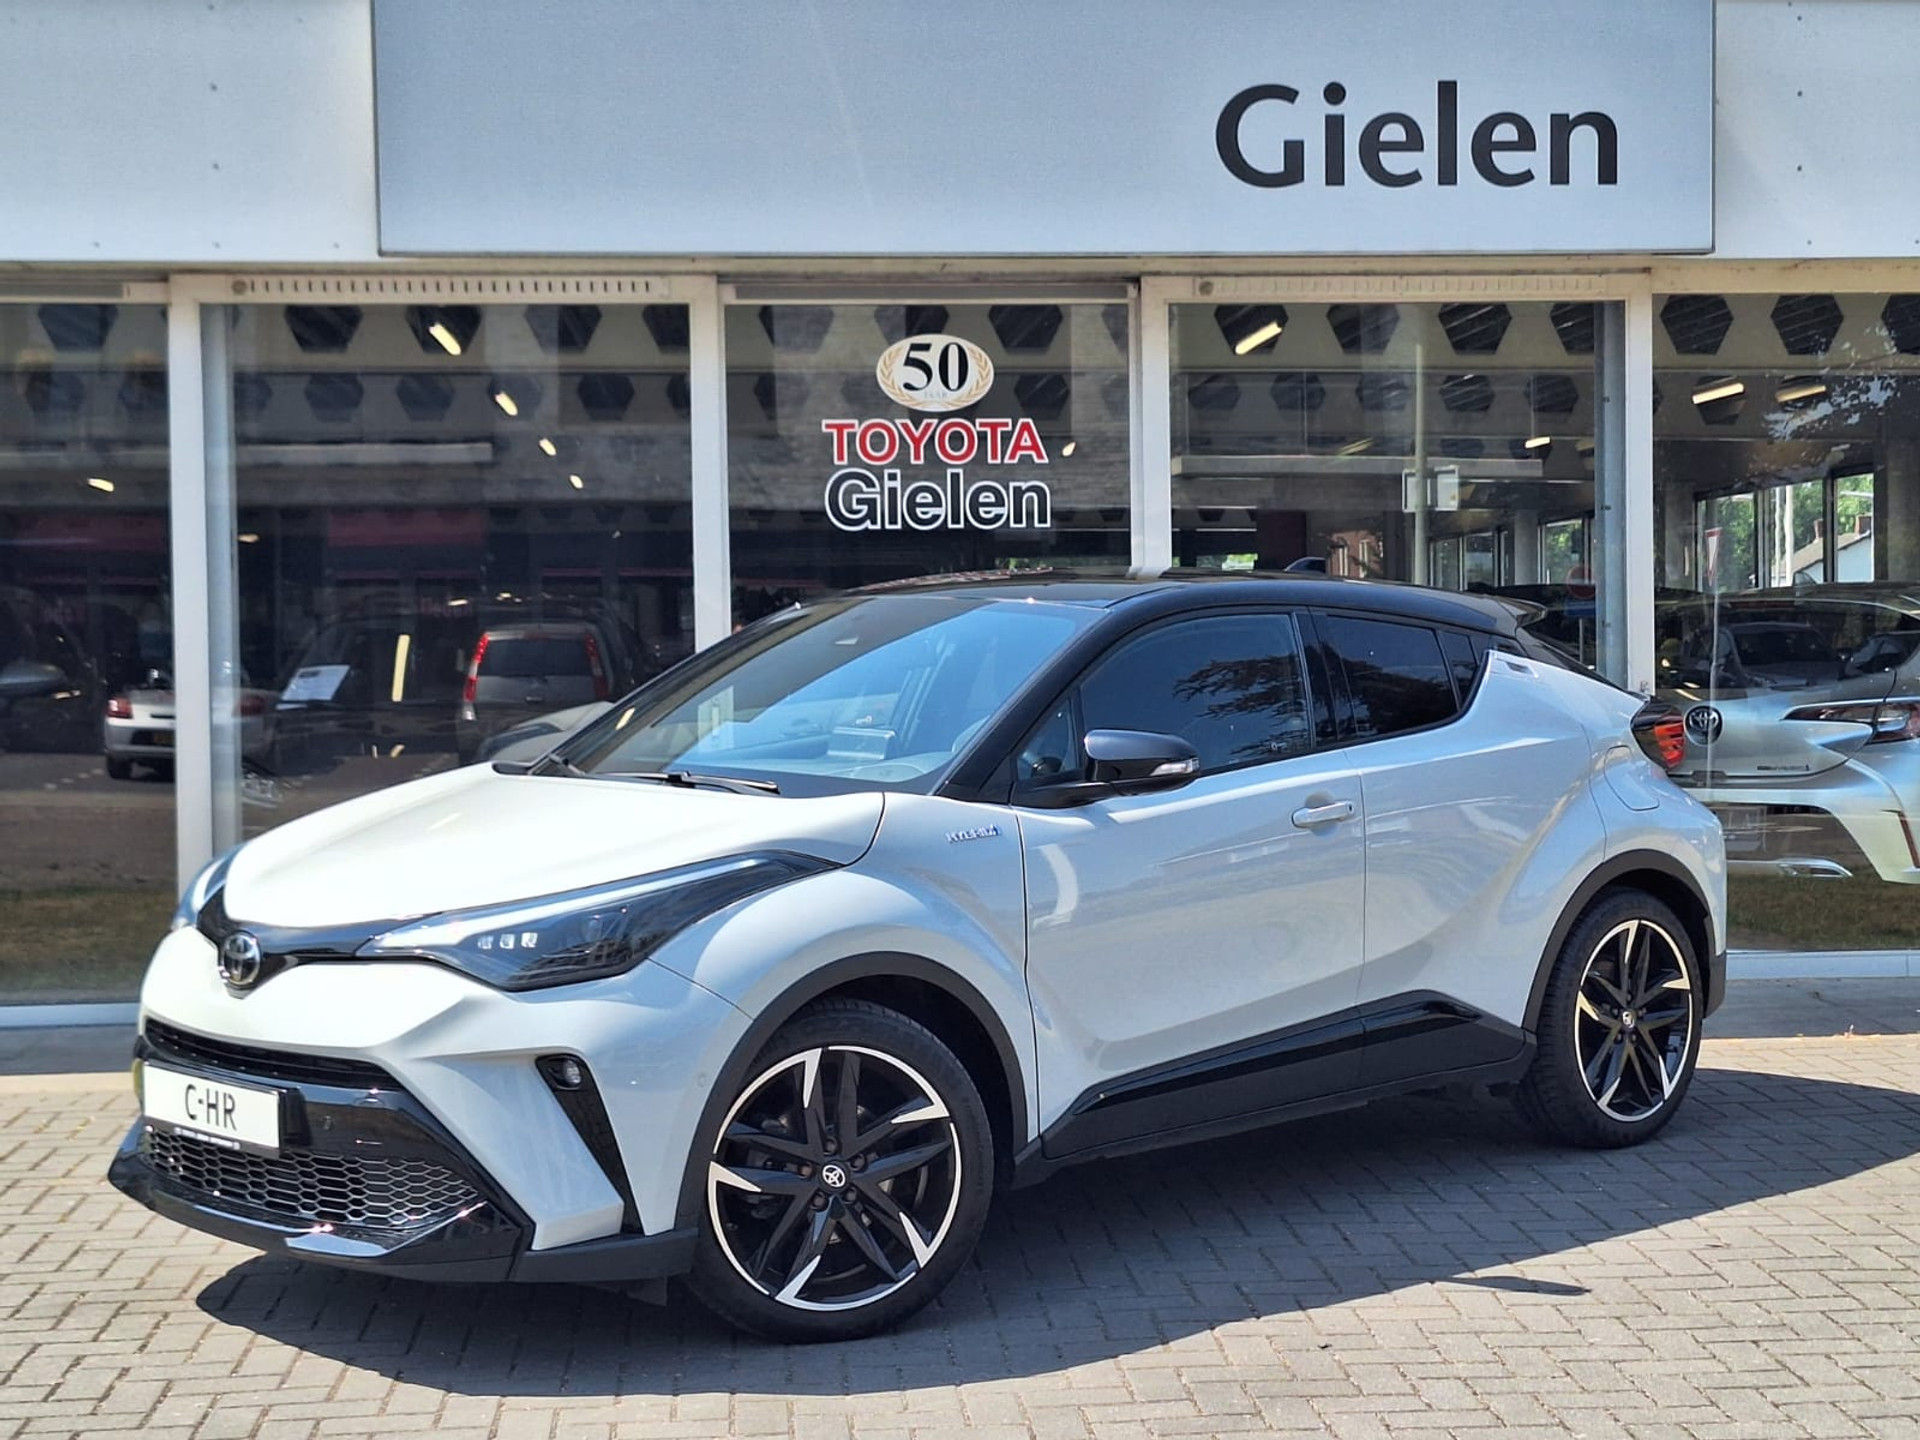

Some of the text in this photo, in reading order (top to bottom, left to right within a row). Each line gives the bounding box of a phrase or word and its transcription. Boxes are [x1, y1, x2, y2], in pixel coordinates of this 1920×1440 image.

[1215, 80, 1618, 188] Gielen
[902, 342, 970, 392] 50
[822, 418, 1049, 465] TOYOTA
[825, 467, 1051, 531] Gielen
[184, 1083, 237, 1132] C-HR
